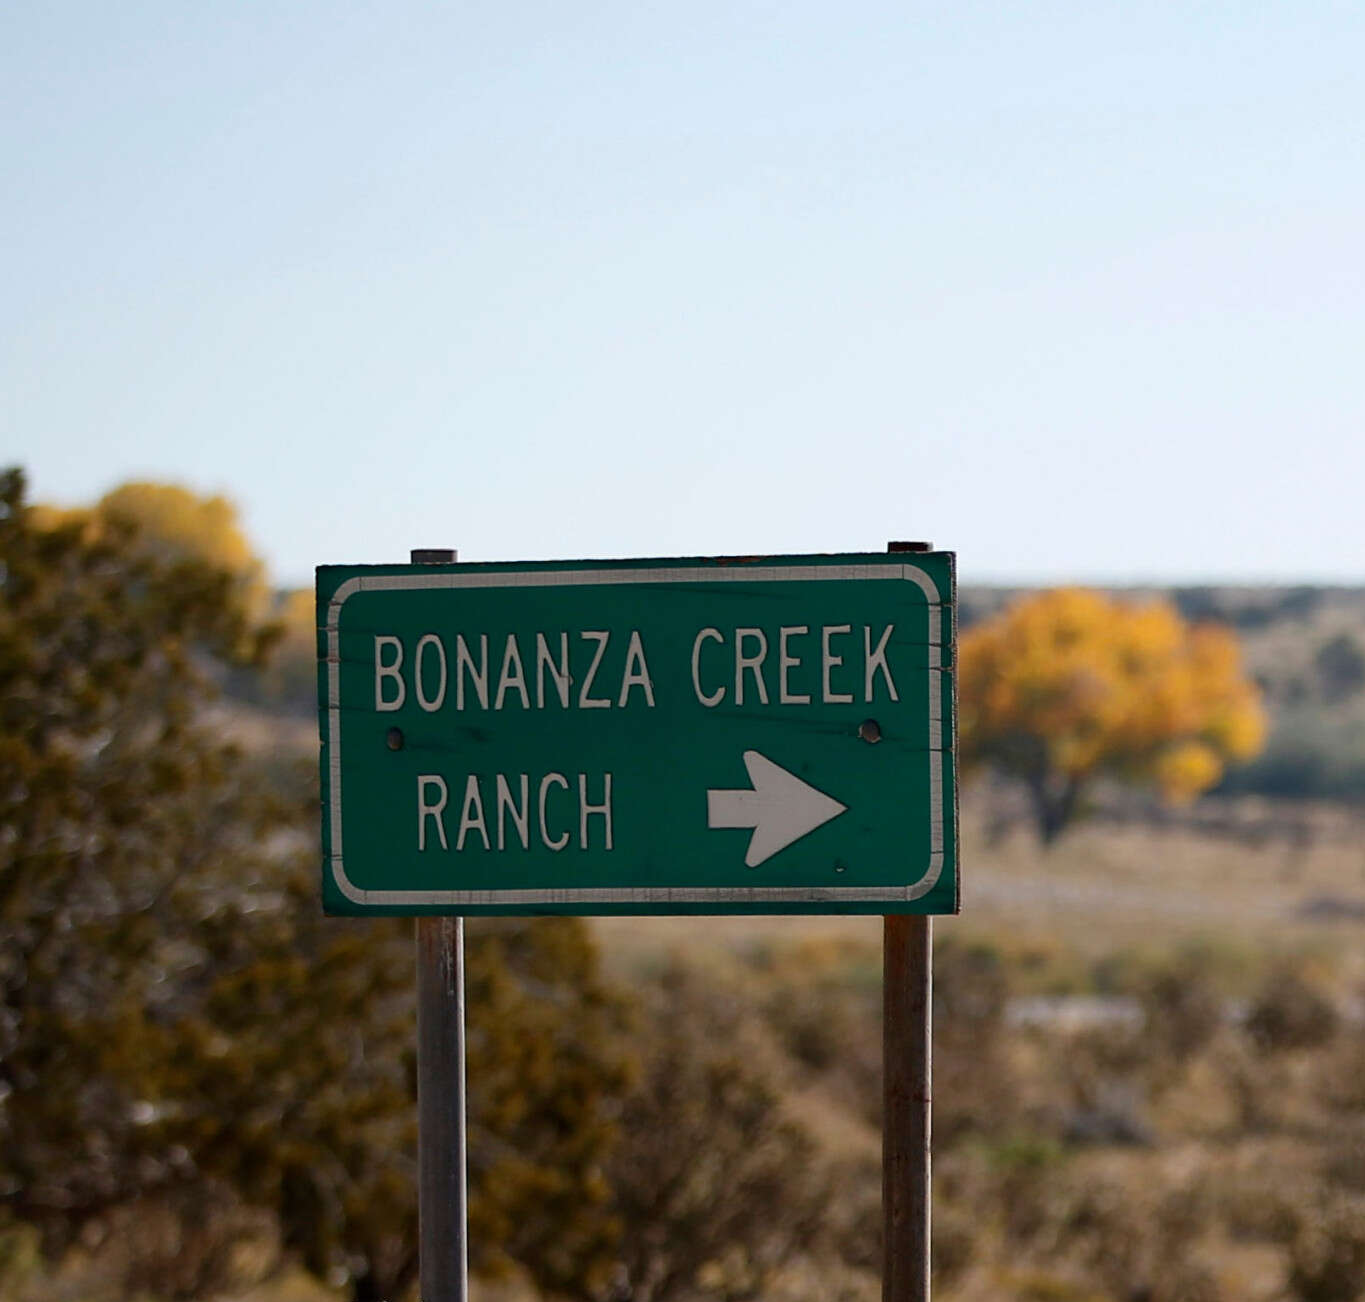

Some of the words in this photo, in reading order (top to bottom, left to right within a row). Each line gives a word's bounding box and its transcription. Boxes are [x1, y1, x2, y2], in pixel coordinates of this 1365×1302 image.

[374, 631, 655, 712] BONANZA
[691, 624, 899, 707] CREEK
[417, 773, 614, 851] RANCH
